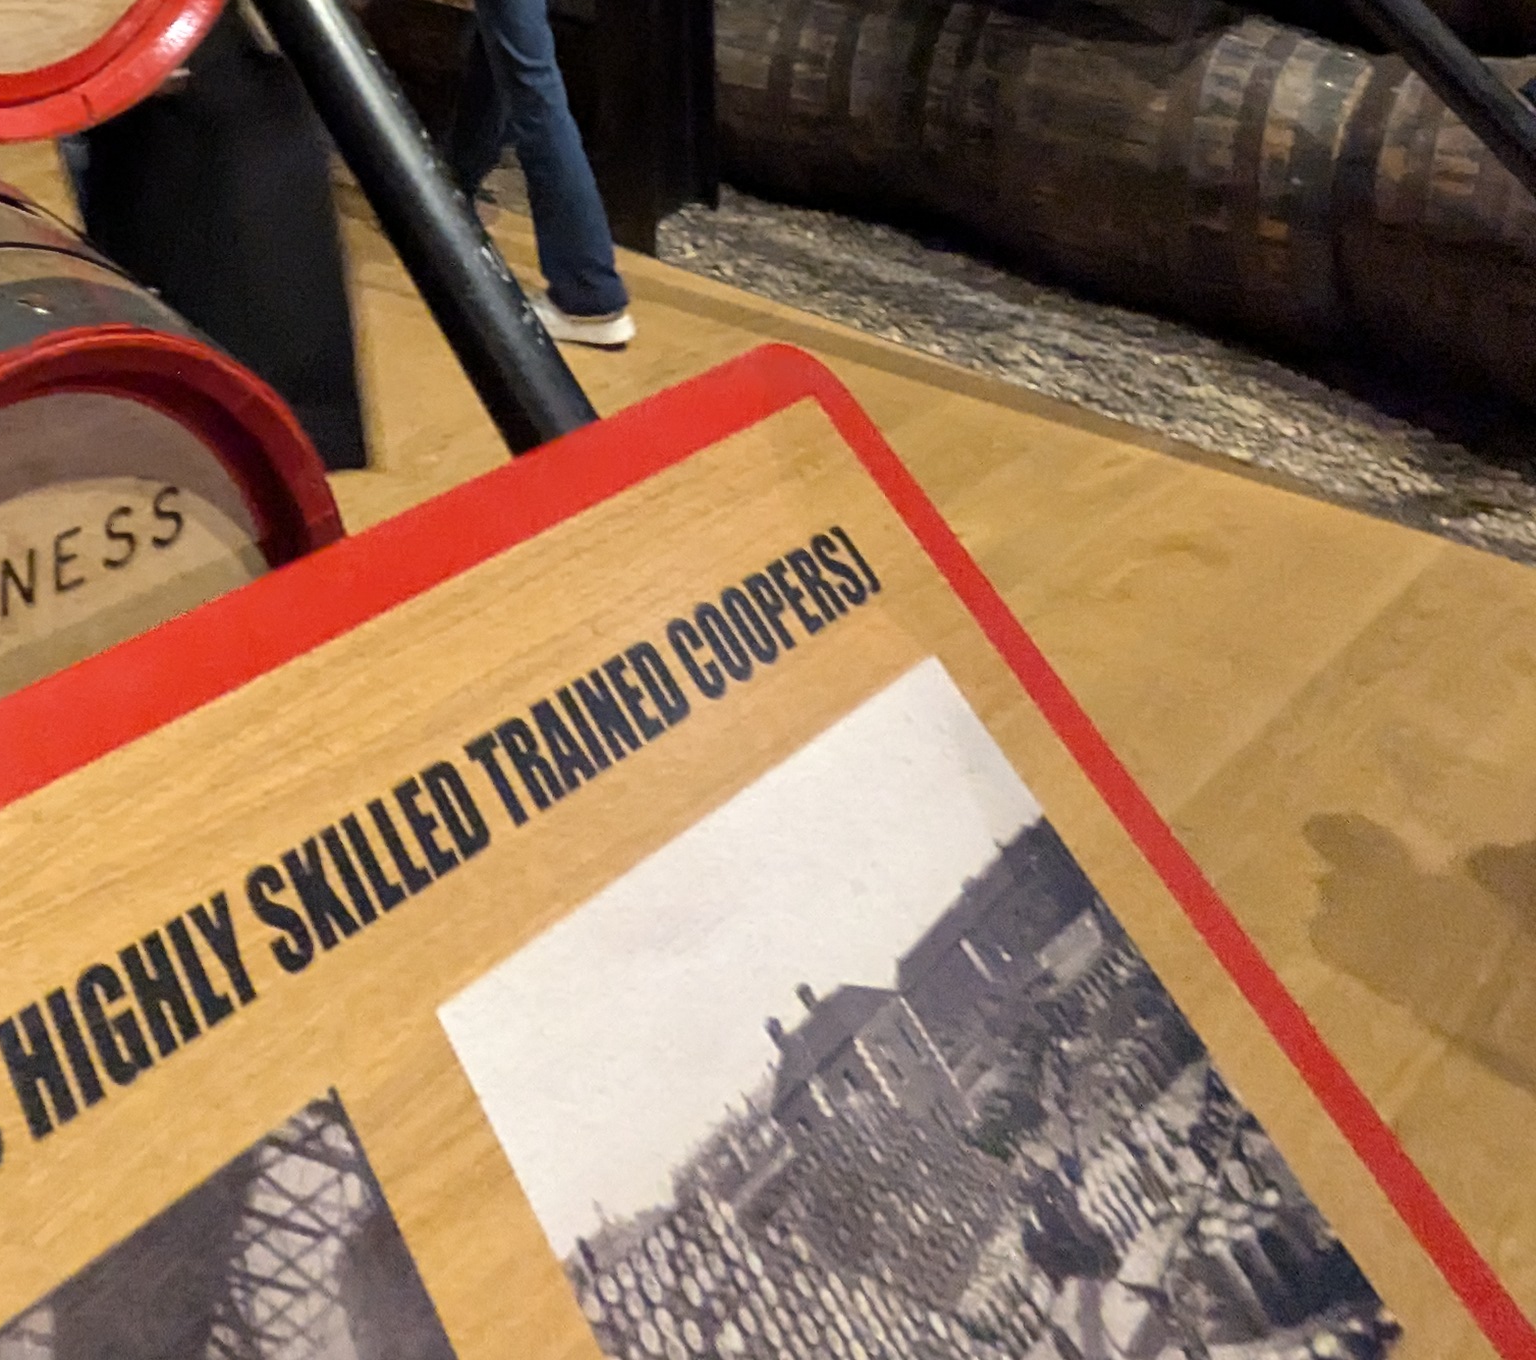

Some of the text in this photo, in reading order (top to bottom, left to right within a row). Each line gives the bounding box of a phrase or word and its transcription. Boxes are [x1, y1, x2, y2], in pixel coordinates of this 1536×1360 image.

[244, 760, 492, 975] SKILLED
[463, 640, 692, 828] TRAINED
[666, 525, 882, 700] COOPERS)
